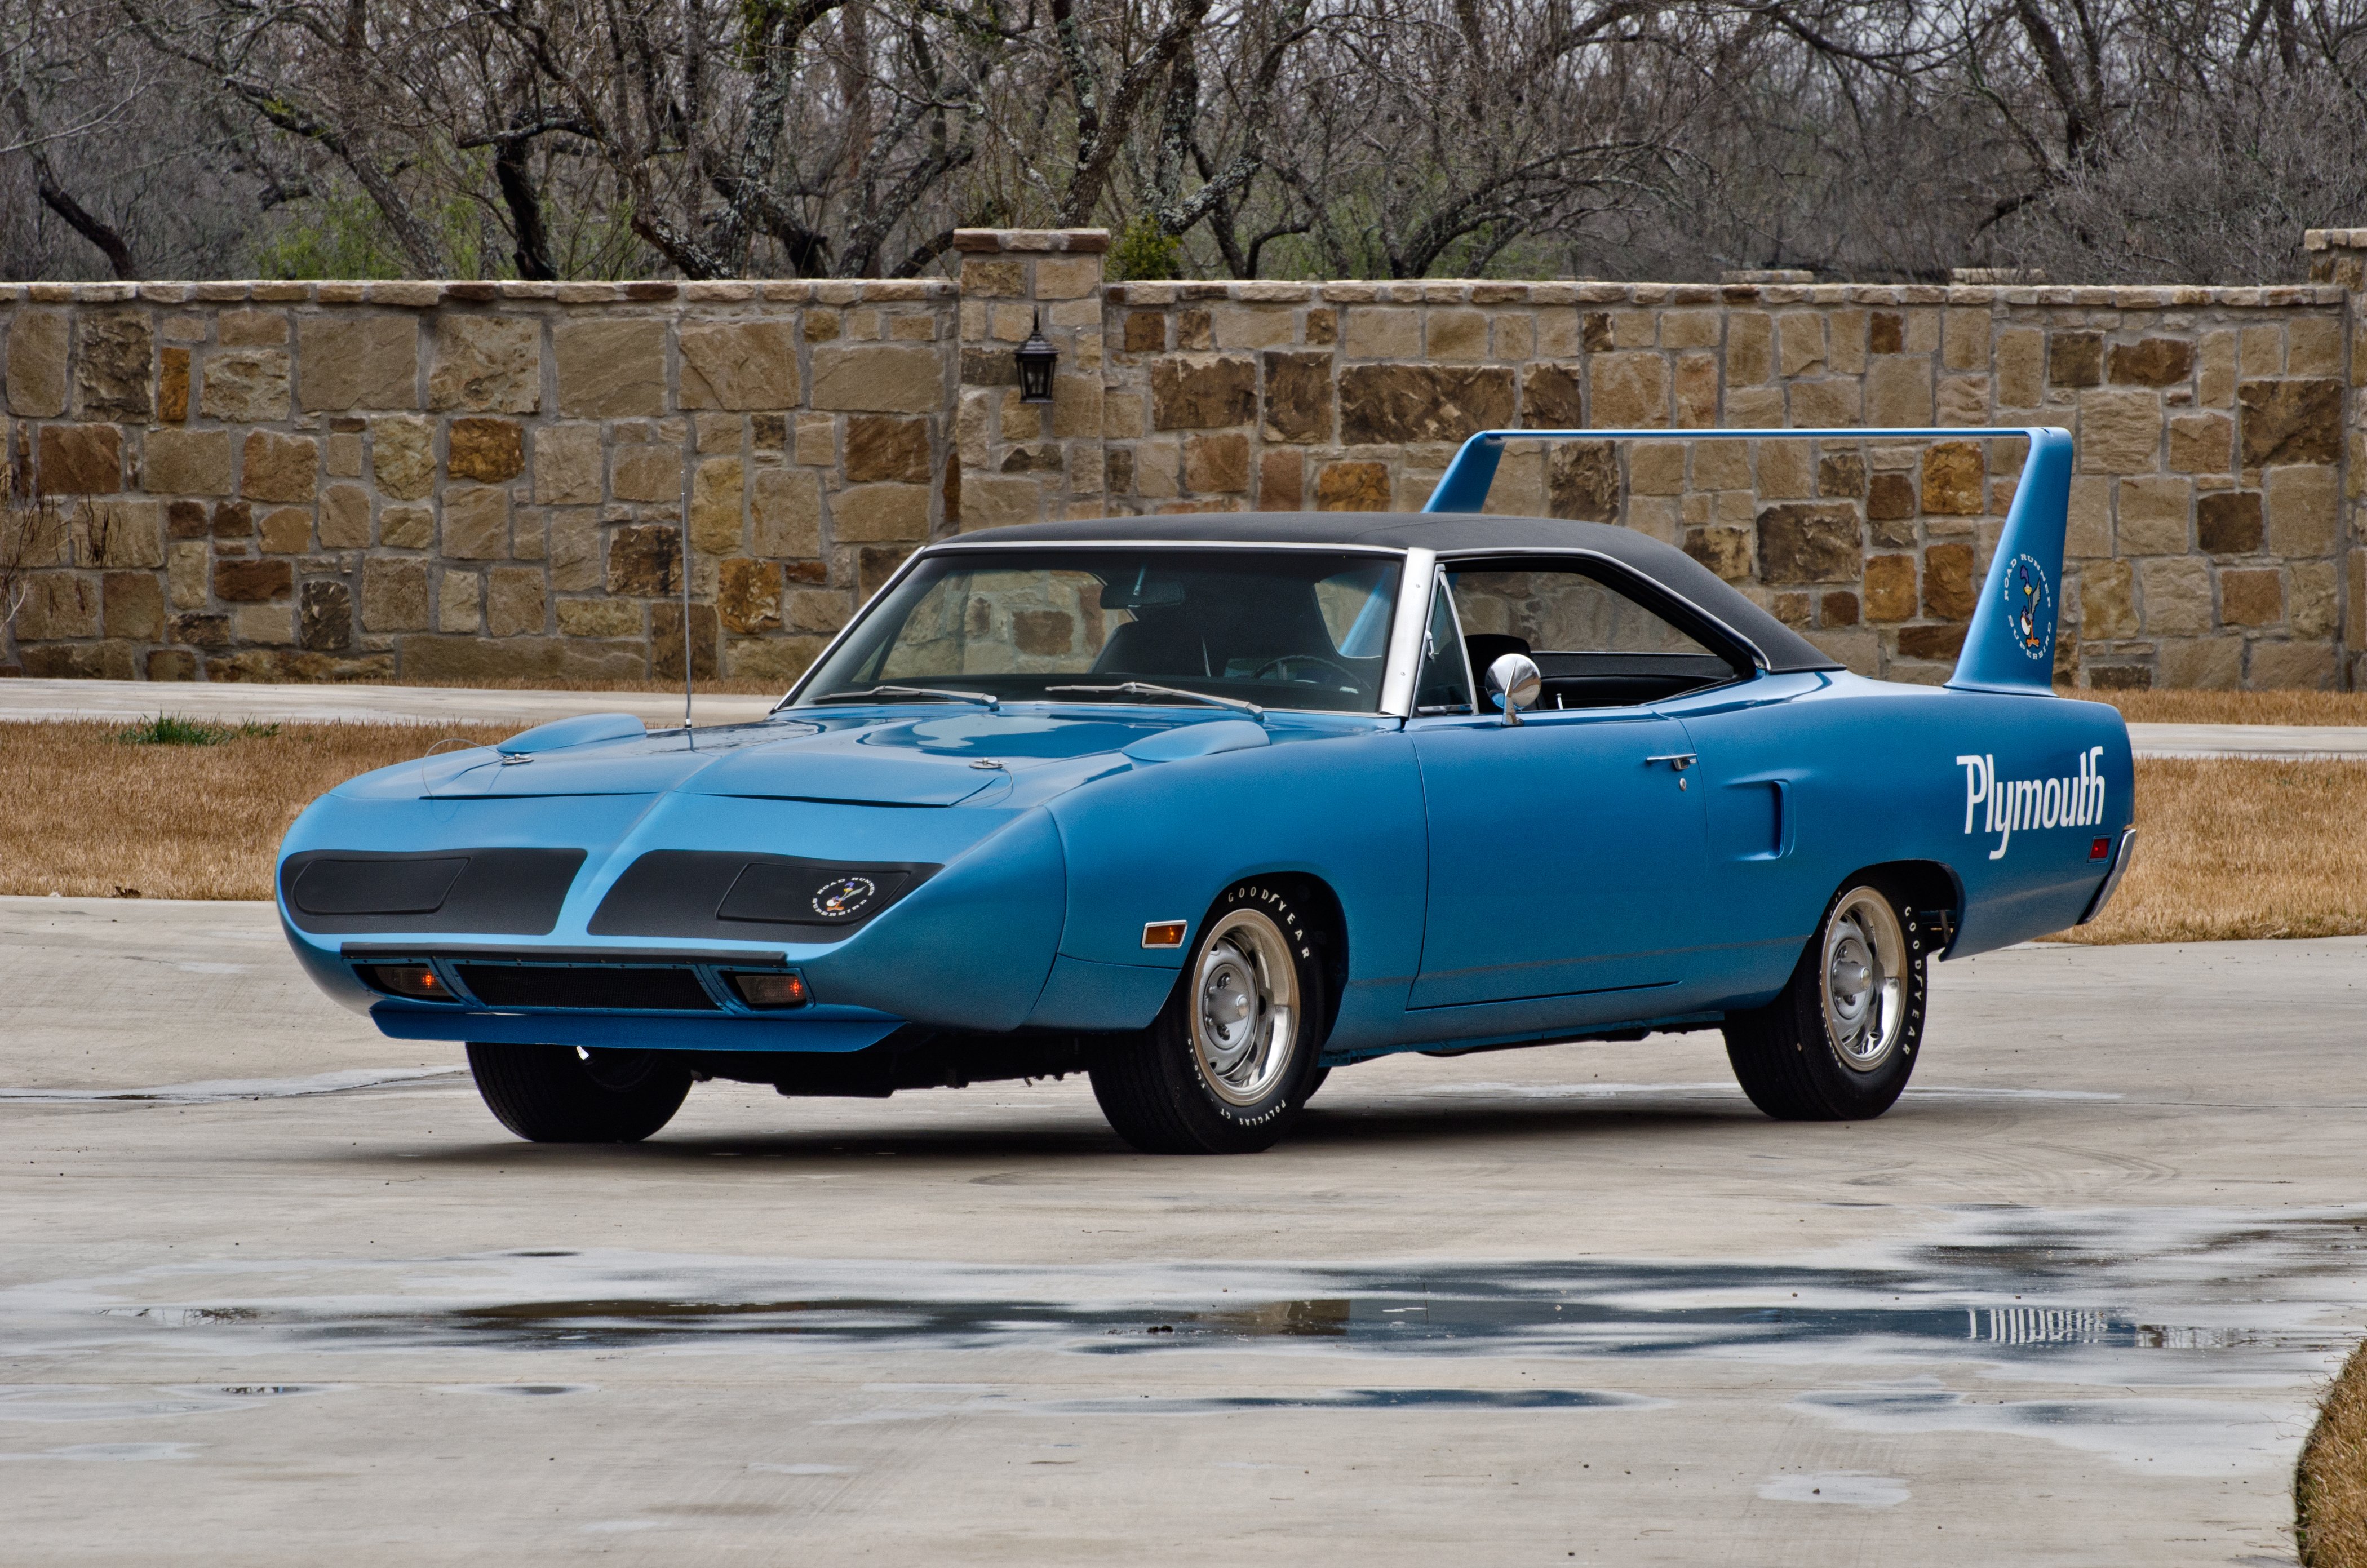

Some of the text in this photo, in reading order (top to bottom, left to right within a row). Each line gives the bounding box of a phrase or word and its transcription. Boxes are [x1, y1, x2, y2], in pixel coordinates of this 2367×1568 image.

[2003, 553, 2051, 608] ROAD RUNNER
[2007, 614, 2051, 661] SUPERBIRD
[1956, 746, 2105, 860] Plymouth
[812, 897, 867, 917] SUPERBIRD
[816, 876, 875, 896] ROAD RUNNER
[1227, 886, 1310, 959] GOODYEAR
[1902, 906, 1922, 1056] GOODYEAR
[1220, 1108, 1231, 1119] GT
[1239, 1099, 1286, 1126] POLYGLAS
